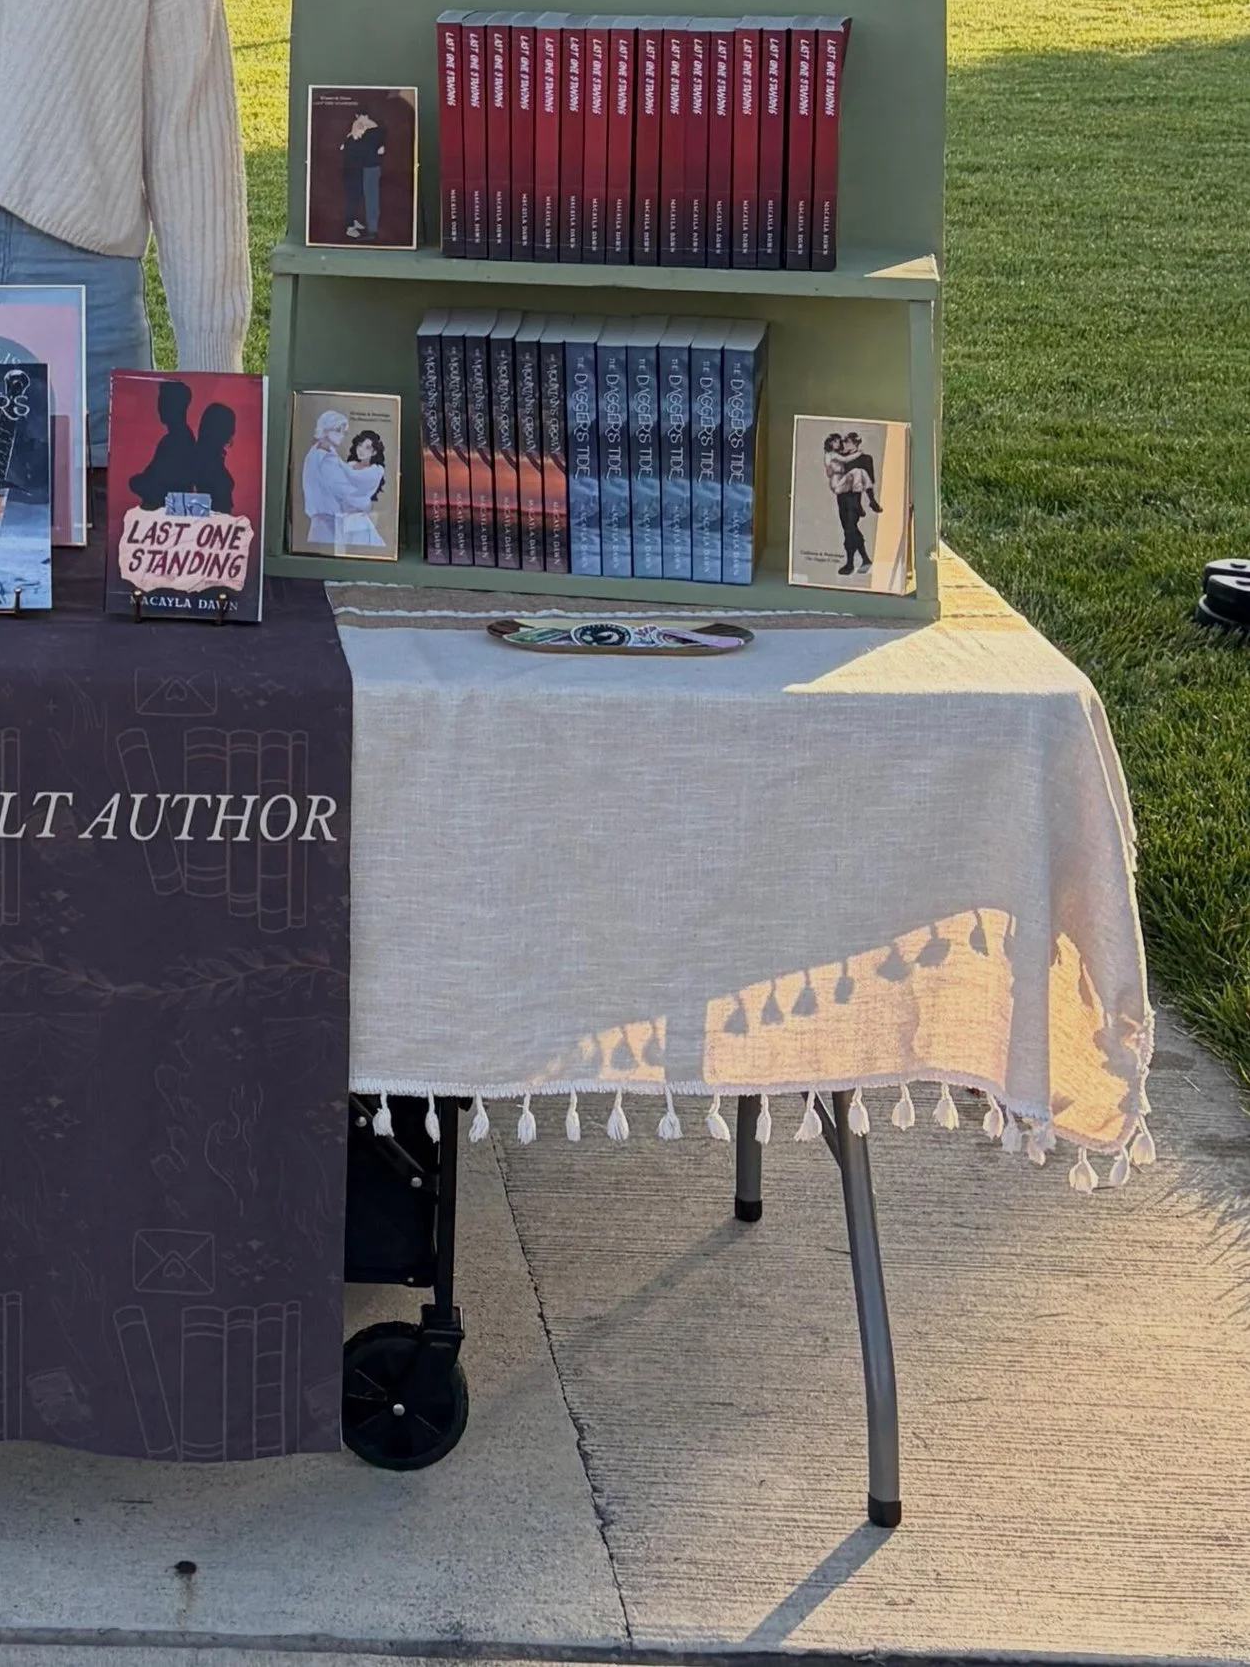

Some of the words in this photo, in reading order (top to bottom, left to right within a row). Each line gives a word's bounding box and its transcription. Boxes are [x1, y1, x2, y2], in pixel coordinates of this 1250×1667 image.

[445, 33, 456, 52] LAST
[494, 34, 503, 53] LAST
[520, 36, 529, 55] LAST
[545, 38, 554, 58] LAST
[592, 39, 602, 59] LAST
[617, 40, 628, 60] LAST
[645, 40, 655, 59] LAST
[693, 39, 702, 58] LAST
[717, 40, 726, 59] LAST
[742, 39, 752, 58] LAST
[799, 39, 809, 59] LAST
[825, 40, 836, 60] LAST
[575, 446, 590, 480] TIDE
[607, 446, 621, 480] TIDE
[638, 447, 652, 480] TIDE
[669, 447, 683, 481] TIDE
[699, 449, 714, 483] TIDE
[729, 452, 744, 485] TIDE
[127, 520, 191, 546] LAST
[196, 524, 246, 550] ONE
[129, 548, 246, 579] STANDING
[80, 792, 338, 842] AUTHOR
